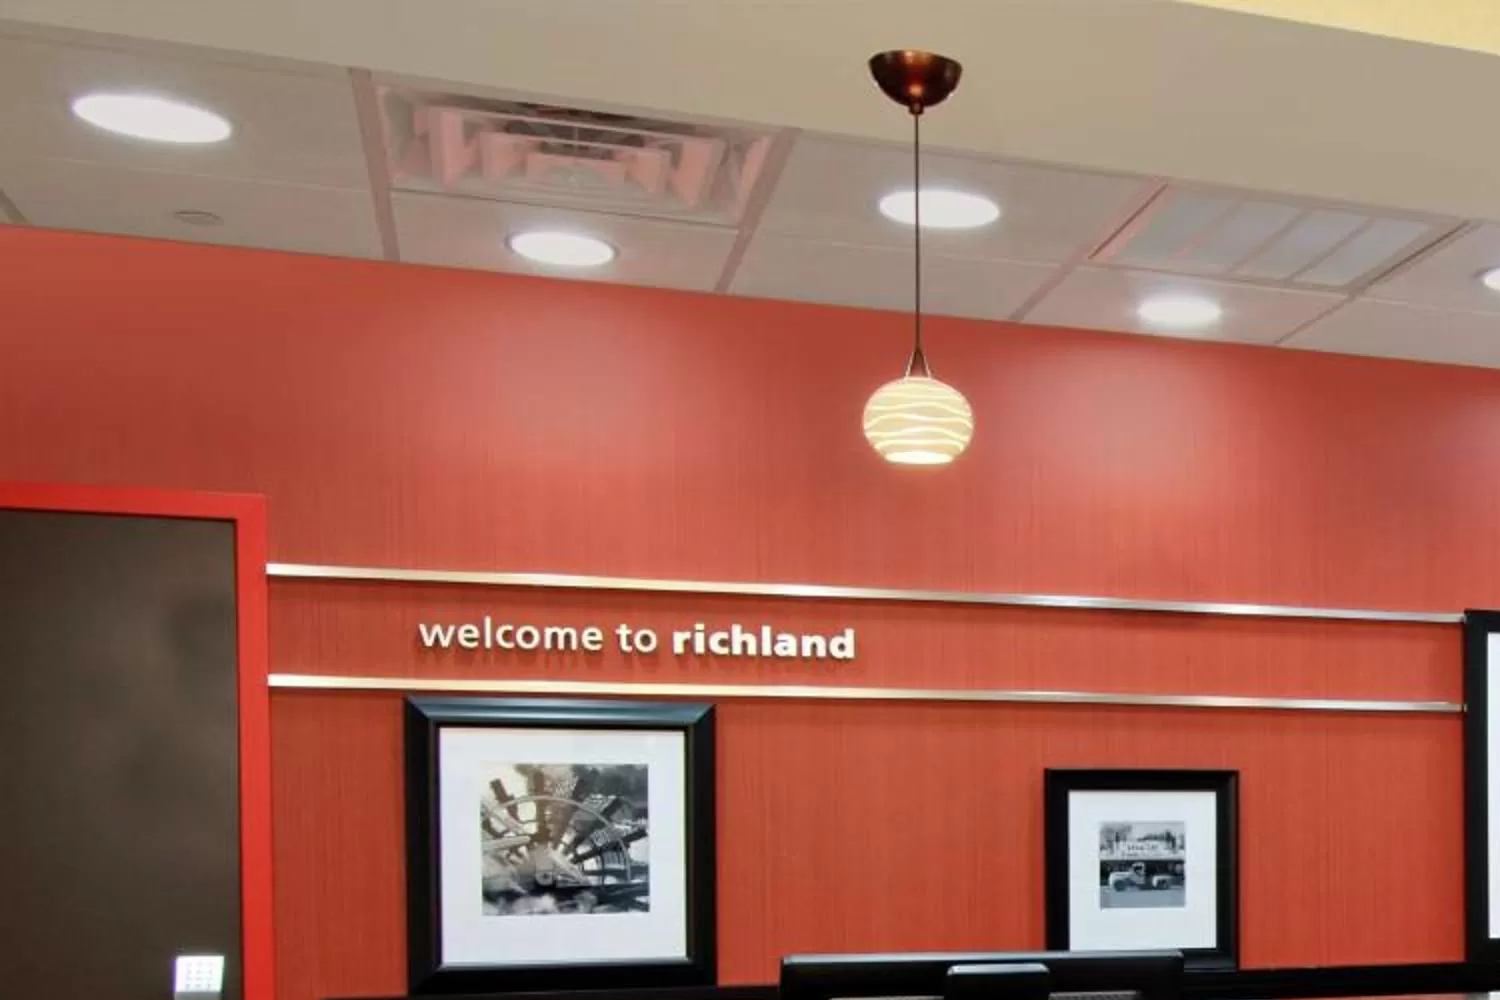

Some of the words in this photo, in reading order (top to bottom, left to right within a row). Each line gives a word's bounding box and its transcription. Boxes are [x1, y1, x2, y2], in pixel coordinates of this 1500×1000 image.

[418, 615, 603, 650] welcome
[616, 623, 657, 652] to
[673, 623, 856, 660] richland
